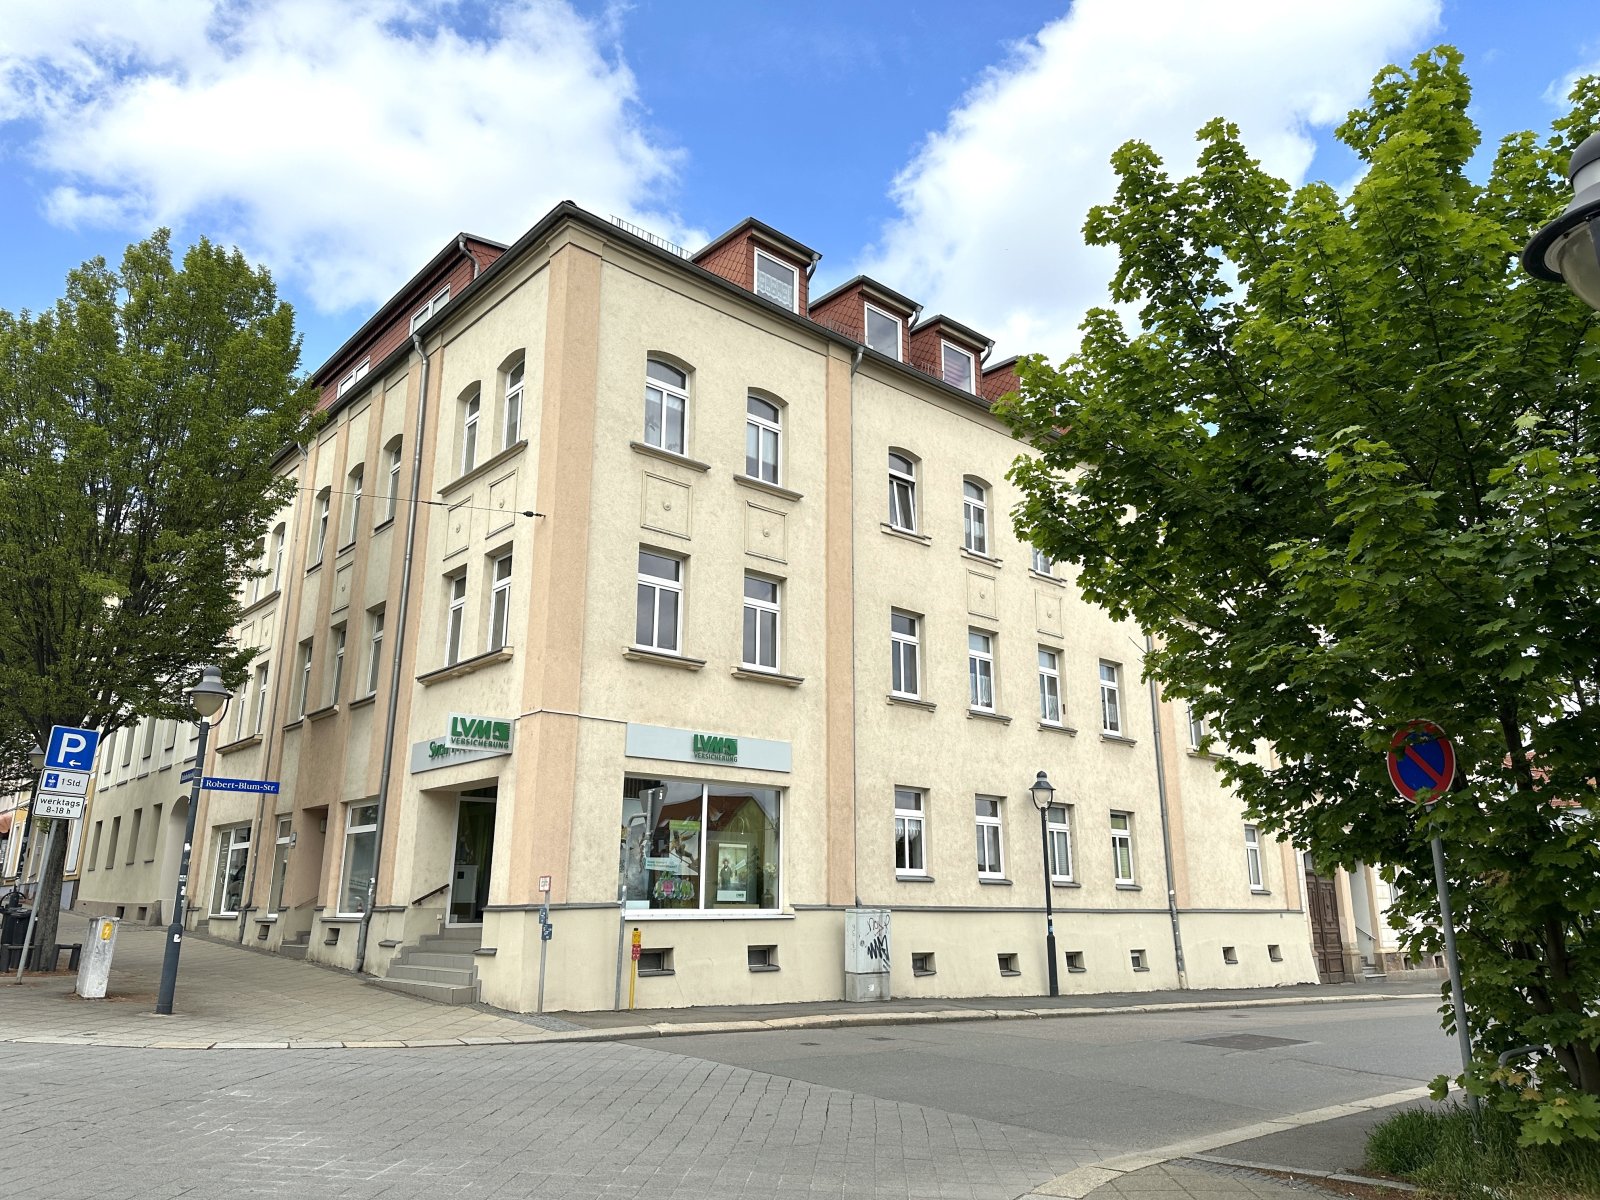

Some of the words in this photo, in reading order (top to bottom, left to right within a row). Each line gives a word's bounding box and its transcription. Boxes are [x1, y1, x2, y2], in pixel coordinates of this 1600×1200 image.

[451, 716, 492, 739] LVM
[57, 733, 87, 763] P
[451, 737, 509, 749] VERSICHERUNG
[693, 734, 724, 753] LVM
[694, 751, 738, 762] VERSICHERUNG
[206, 779, 277, 792] Robert-Blum-Str.
[40, 797, 80, 808] werktags
[46, 806, 64, 814] 8-18
